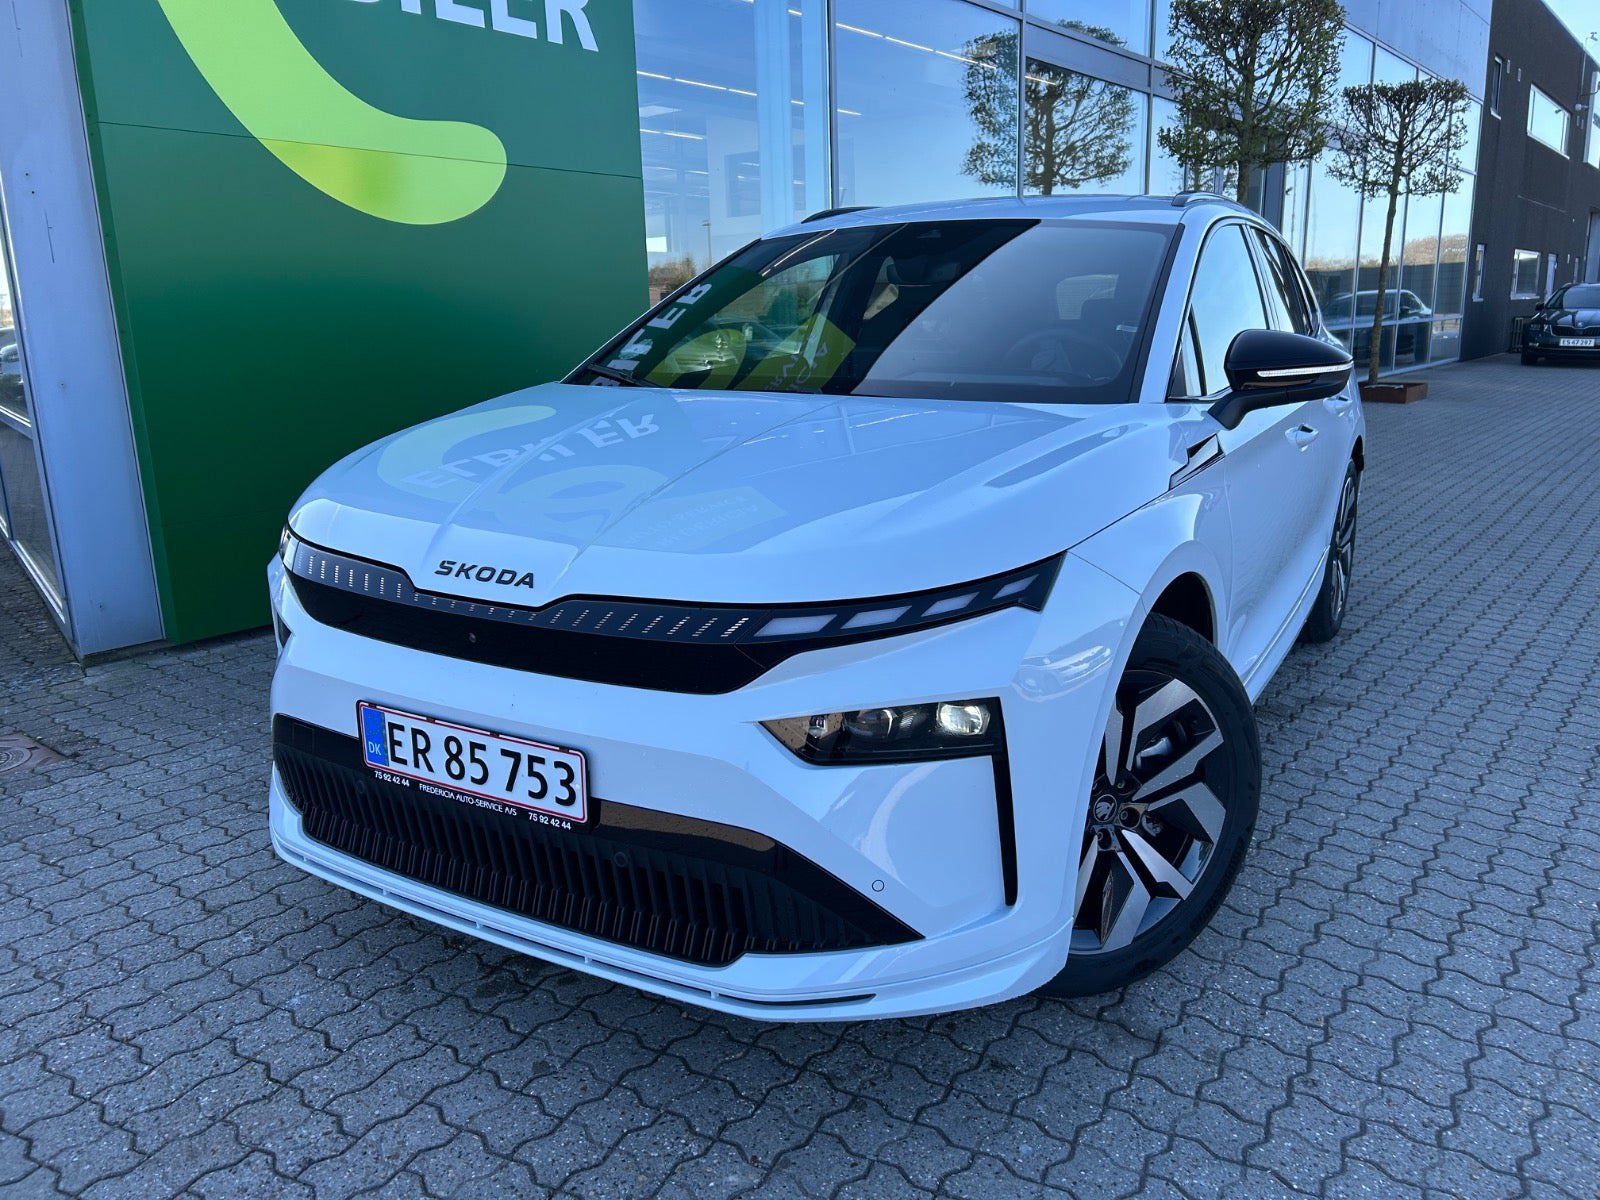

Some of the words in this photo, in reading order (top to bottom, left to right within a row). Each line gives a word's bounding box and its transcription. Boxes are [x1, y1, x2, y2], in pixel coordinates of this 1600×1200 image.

[368, 741, 382, 756] DK
[387, 721, 435, 774] ER
[443, 735, 490, 786] 85
[500, 748, 577, 807] 753
[374, 770, 383, 780] 75
[383, 772, 392, 783] 92
[392, 775, 401, 785] 42
[401, 778, 410, 788] 44
[418, 783, 456, 800] FREDERICIA
[455, 793, 504, 813] AUTO-SERVICE
[504, 806, 518, 816] A/S
[528, 811, 538, 822] 75
[538, 814, 549, 825] 92
[549, 817, 561, 828] 42
[561, 820, 572, 831] 44
